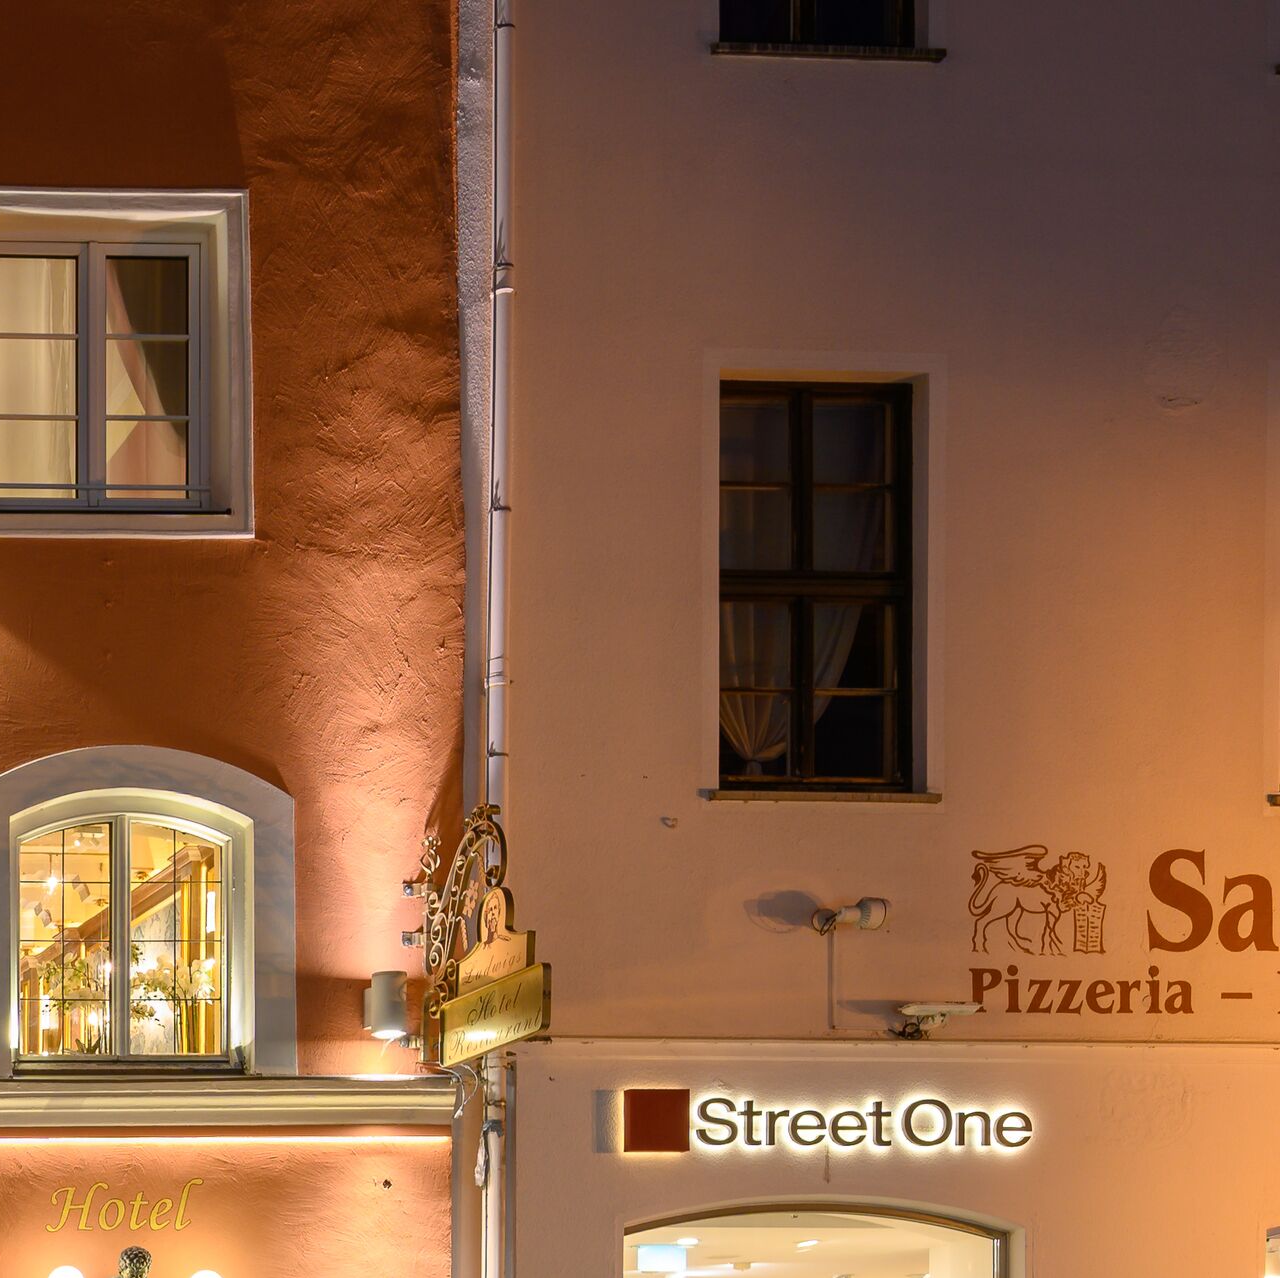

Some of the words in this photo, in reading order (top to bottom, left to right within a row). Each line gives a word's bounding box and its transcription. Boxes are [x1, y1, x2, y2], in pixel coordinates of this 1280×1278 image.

[1146, 848, 1280, 953] Sa
[462, 951, 522, 985] Ludwigs
[969, 964, 1194, 1015] Pizzeria
[467, 982, 522, 1027] Hotel
[45, 1177, 205, 1233] Hotel
